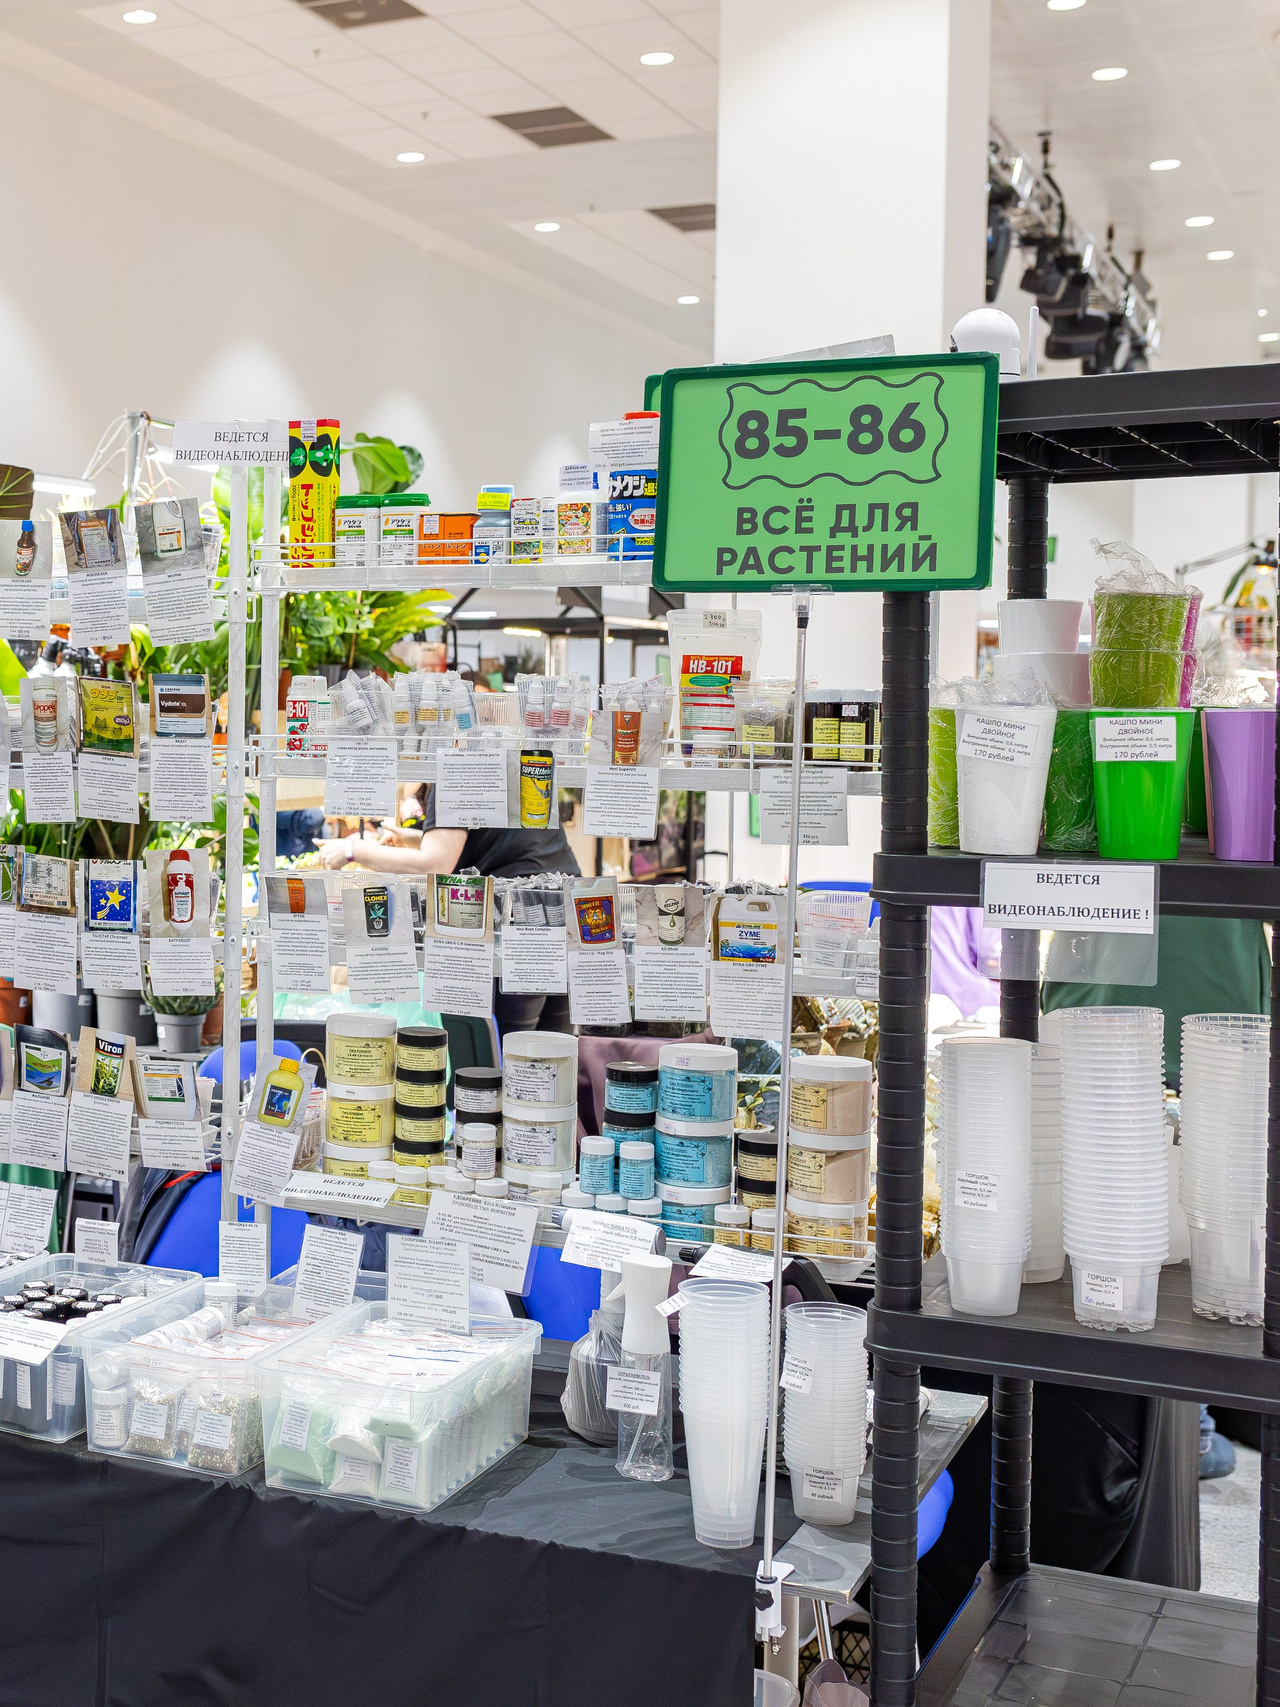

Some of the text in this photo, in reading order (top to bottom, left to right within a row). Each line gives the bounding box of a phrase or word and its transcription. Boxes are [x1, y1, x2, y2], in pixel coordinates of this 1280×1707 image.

[214, 431, 269, 443] ВЕДЕТСЯ
[733, 402, 926, 460] 85-86
[735, 497, 919, 539] ВСЁ ДЛЯ
[715, 534, 938, 576] РАСТЕНИЙ
[689, 659, 732, 674] HB-101
[90, 688, 119, 699] ウララ
[976, 717, 1026, 731] КАШПО МИНИ
[981, 727, 1016, 739] ДВОЙНОЕ
[1117, 728, 1154, 736] ДВОЙНОЕ
[974, 748, 1015, 762] 170 рублей
[1114, 751, 1159, 759] 170 рублей
[1035, 872, 1101, 888] ВЕДЕТСЯ
[450, 888, 484, 901] K-L-N
[987, 903, 1141, 921] ВИДЕОНАБЛЮДЕНИЕ
[738, 930, 761, 938] ZYME
[98, 1039, 123, 1054] Viron
[965, 1172, 989, 1180] ГОРШОК
[323, 1179, 365, 1187] ВЕДЕТСЯ
[284, 1187, 383, 1203] ВИДЕОНАБЛЮДЕНИЕ
[452, 1194, 482, 1204] УДОБРЕНИЕ
[490, 1208, 516, 1217] НОРВЕГИЯ
[1087, 1272, 1117, 1283] ГОРШОК
